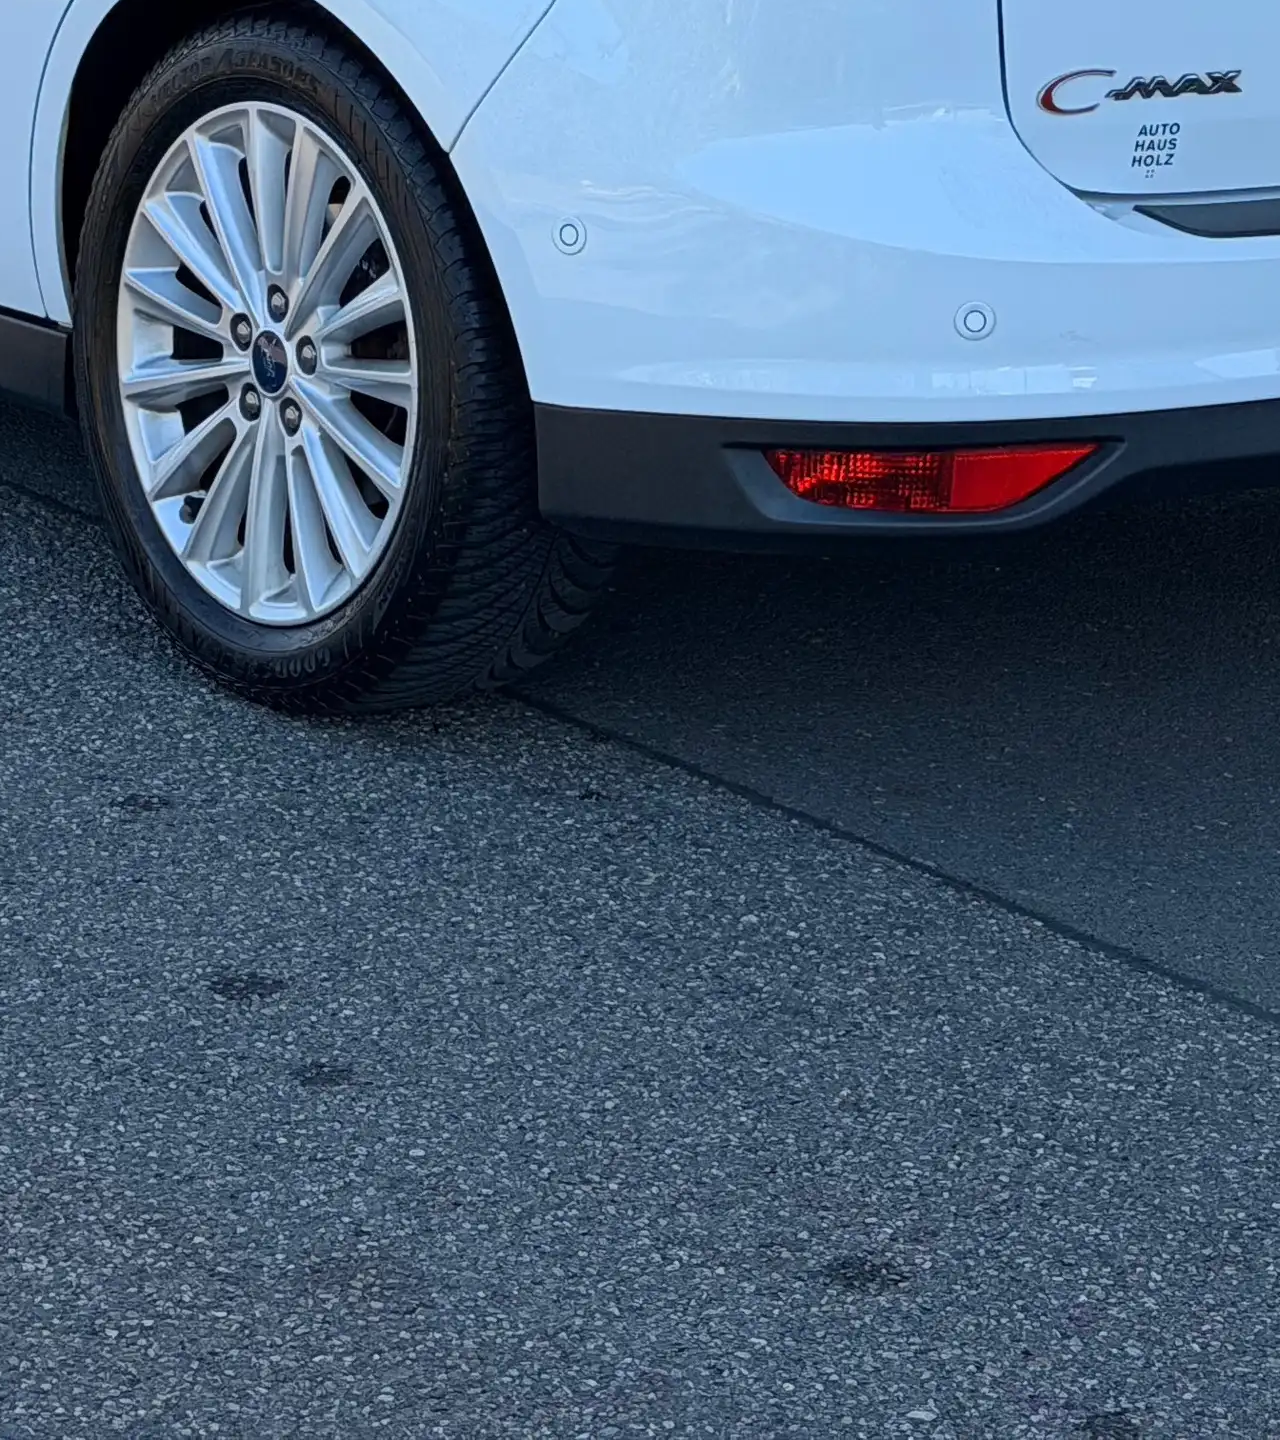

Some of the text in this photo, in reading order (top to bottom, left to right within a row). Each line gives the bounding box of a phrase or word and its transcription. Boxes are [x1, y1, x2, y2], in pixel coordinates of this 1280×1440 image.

[1137, 122, 1181, 137] AUTO
[1134, 137, 1178, 153] HAUS
[1131, 153, 1175, 168] HOLZ
